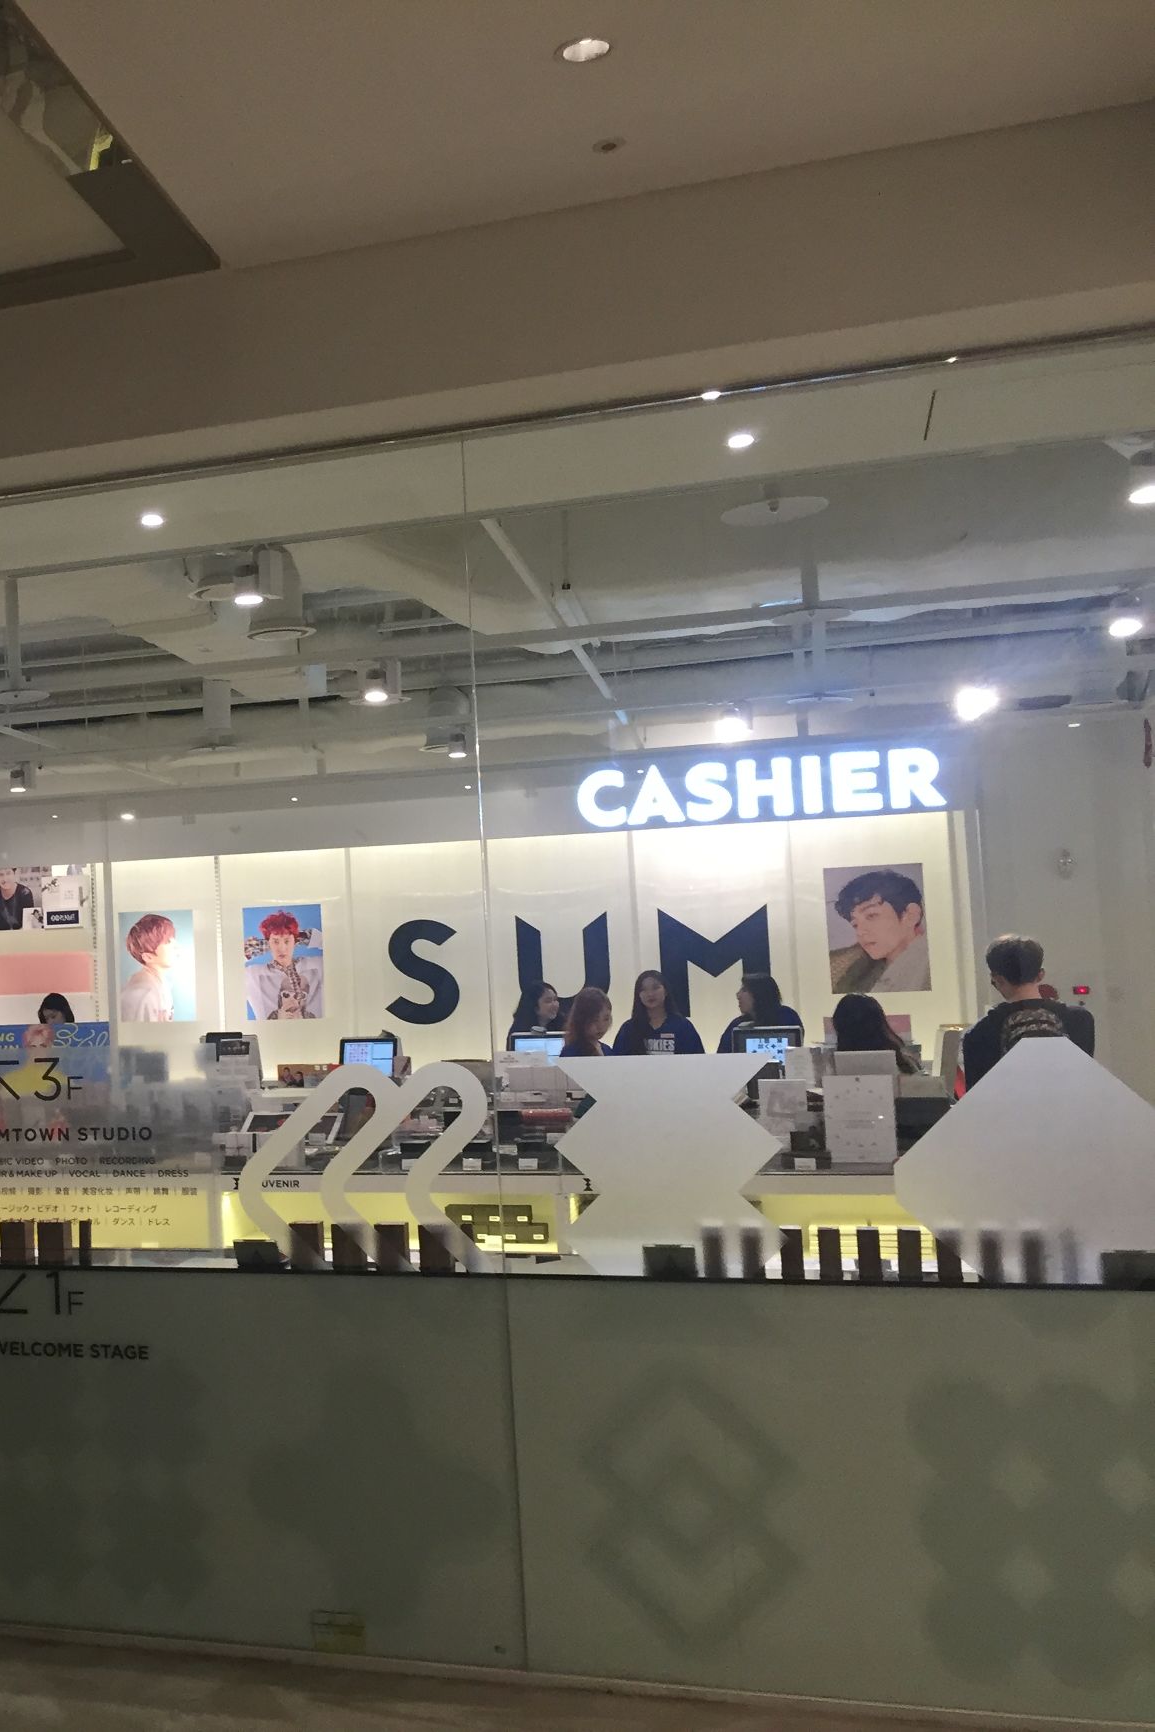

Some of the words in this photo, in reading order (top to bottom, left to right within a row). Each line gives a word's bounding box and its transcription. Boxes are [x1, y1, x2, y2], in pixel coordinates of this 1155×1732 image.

[577, 747, 947, 828] CASHIER
[385, 904, 771, 1025] SUM
[78, 1127, 152, 1141] STUDIO
[15, 1157, 45, 1165] VIDEO
[55, 1157, 88, 1165] PHOTO
[99, 1156, 156, 1165] RECORDING
[112, 1169, 146, 1177] DANCE
[158, 1169, 189, 1177] DRESS
[262, 1180, 299, 1188] UVENIR
[90, 1343, 149, 1360] STAGE
